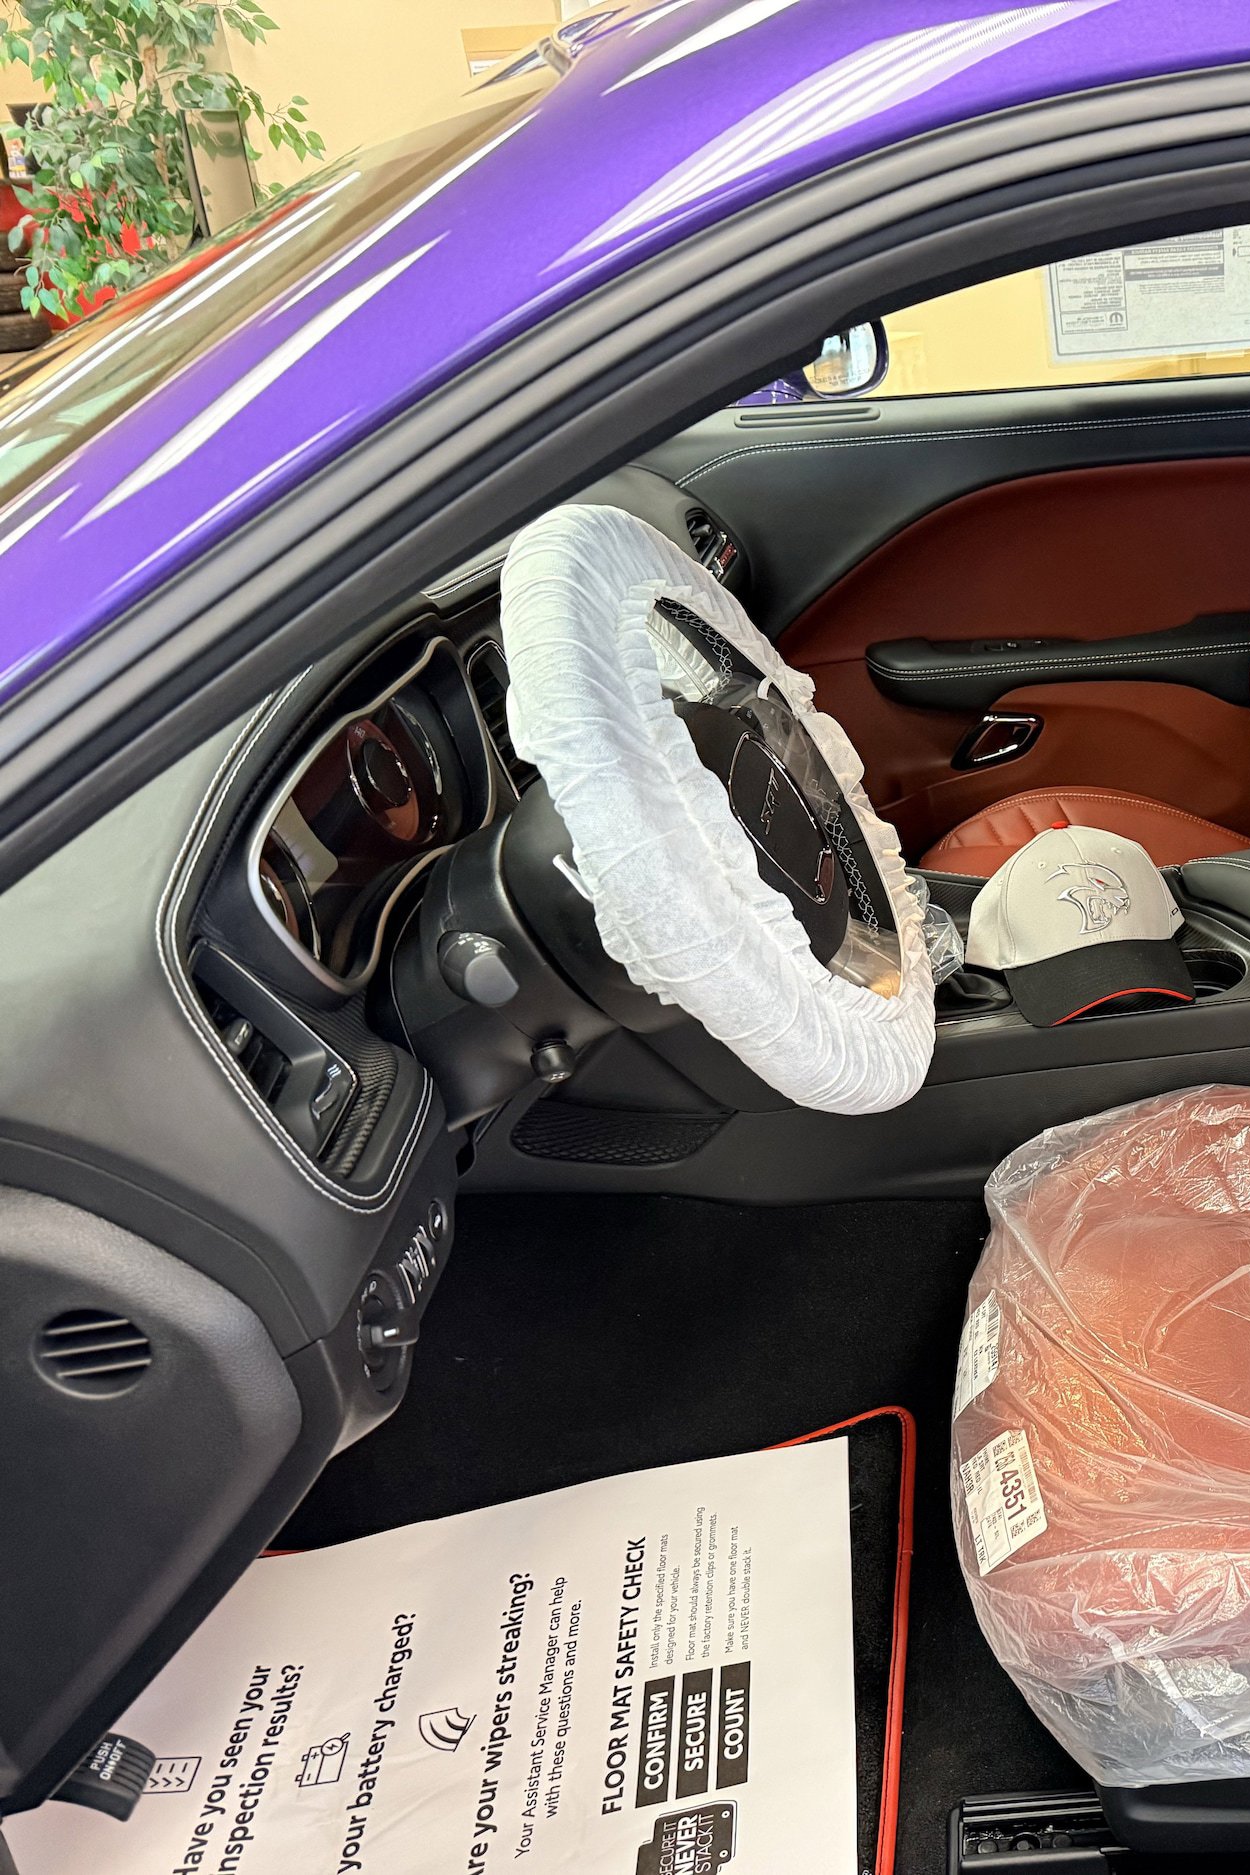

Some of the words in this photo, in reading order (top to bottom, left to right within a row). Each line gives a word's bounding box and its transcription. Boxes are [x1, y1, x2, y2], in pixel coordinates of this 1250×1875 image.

[999, 1467, 1027, 1521] 4351
[694, 1506, 706, 1525] using
[660, 1533, 669, 1552] mats
[692, 1525, 703, 1556] secured
[730, 1526, 739, 1540] mat
[656, 1554, 667, 1571] floor
[691, 1557, 701, 1568] be
[728, 1542, 738, 1559] floor
[742, 1555, 752, 1574] stack
[622, 1536, 646, 1599] CHECK
[689, 1568, 702, 1593] always
[705, 1561, 717, 1578] clips
[729, 1560, 737, 1575] one
[548, 1577, 568, 1609] help
[654, 1573, 666, 1606] specified
[704, 1579, 714, 1613] retention
[726, 1576, 737, 1595] have
[740, 1576, 751, 1603] double
[568, 1600, 582, 1636] more.
[652, 1609, 663, 1622] the
[670, 1595, 679, 1612] your
[688, 1595, 698, 1621] should
[728, 1596, 738, 1611] you
[496, 1573, 534, 1684] streaking?
[548, 1608, 562, 1636] can
[651, 1623, 663, 1640] only
[666, 1614, 677, 1625] for
[688, 1622, 697, 1638] mat
[700, 1615, 714, 1642] factory
[727, 1613, 735, 1630] sure
[740, 1605, 750, 1632] NEVER
[563, 1640, 577, 1666] and
[615, 1606, 639, 1678] SAFETY
[649, 1642, 660, 1668] Install
[663, 1626, 677, 1664] designed
[685, 1640, 696, 1660] Floor
[700, 1644, 711, 1657] the
[724, 1631, 735, 1653] Make
[739, 1634, 749, 1649] and
[373, 1613, 416, 1712] charged?
[538, 1635, 560, 1694] Manager
[261, 1664, 304, 1746] results?
[557, 1669, 574, 1736] questions
[610, 1685, 632, 1730] MAT
[480, 1691, 513, 1772] wipers
[530, 1697, 551, 1746] Service
[684, 1692, 706, 1770] SECURE
[723, 1687, 743, 1759] COUNT
[200, 1774, 233, 1817] you
[220, 1717, 254, 1767] seen
[239, 1665, 271, 1712] your
[644, 1691, 668, 1789] CONFIRM
[90, 1742, 113, 1771] PUSH
[346, 1720, 396, 1810] battery
[547, 1741, 566, 1781] these
[521, 1749, 544, 1817] Assistant
[601, 1733, 629, 1814] FLOOR
[473, 1778, 498, 1837] your
[544, 1785, 561, 1818] with
[663, 1822, 677, 1831] IT
[698, 1813, 714, 1825] IT
[337, 1815, 366, 1875] your
[514, 1823, 533, 1858] Your
[674, 1814, 699, 1875] NEVER
[695, 1826, 713, 1873] STACK
